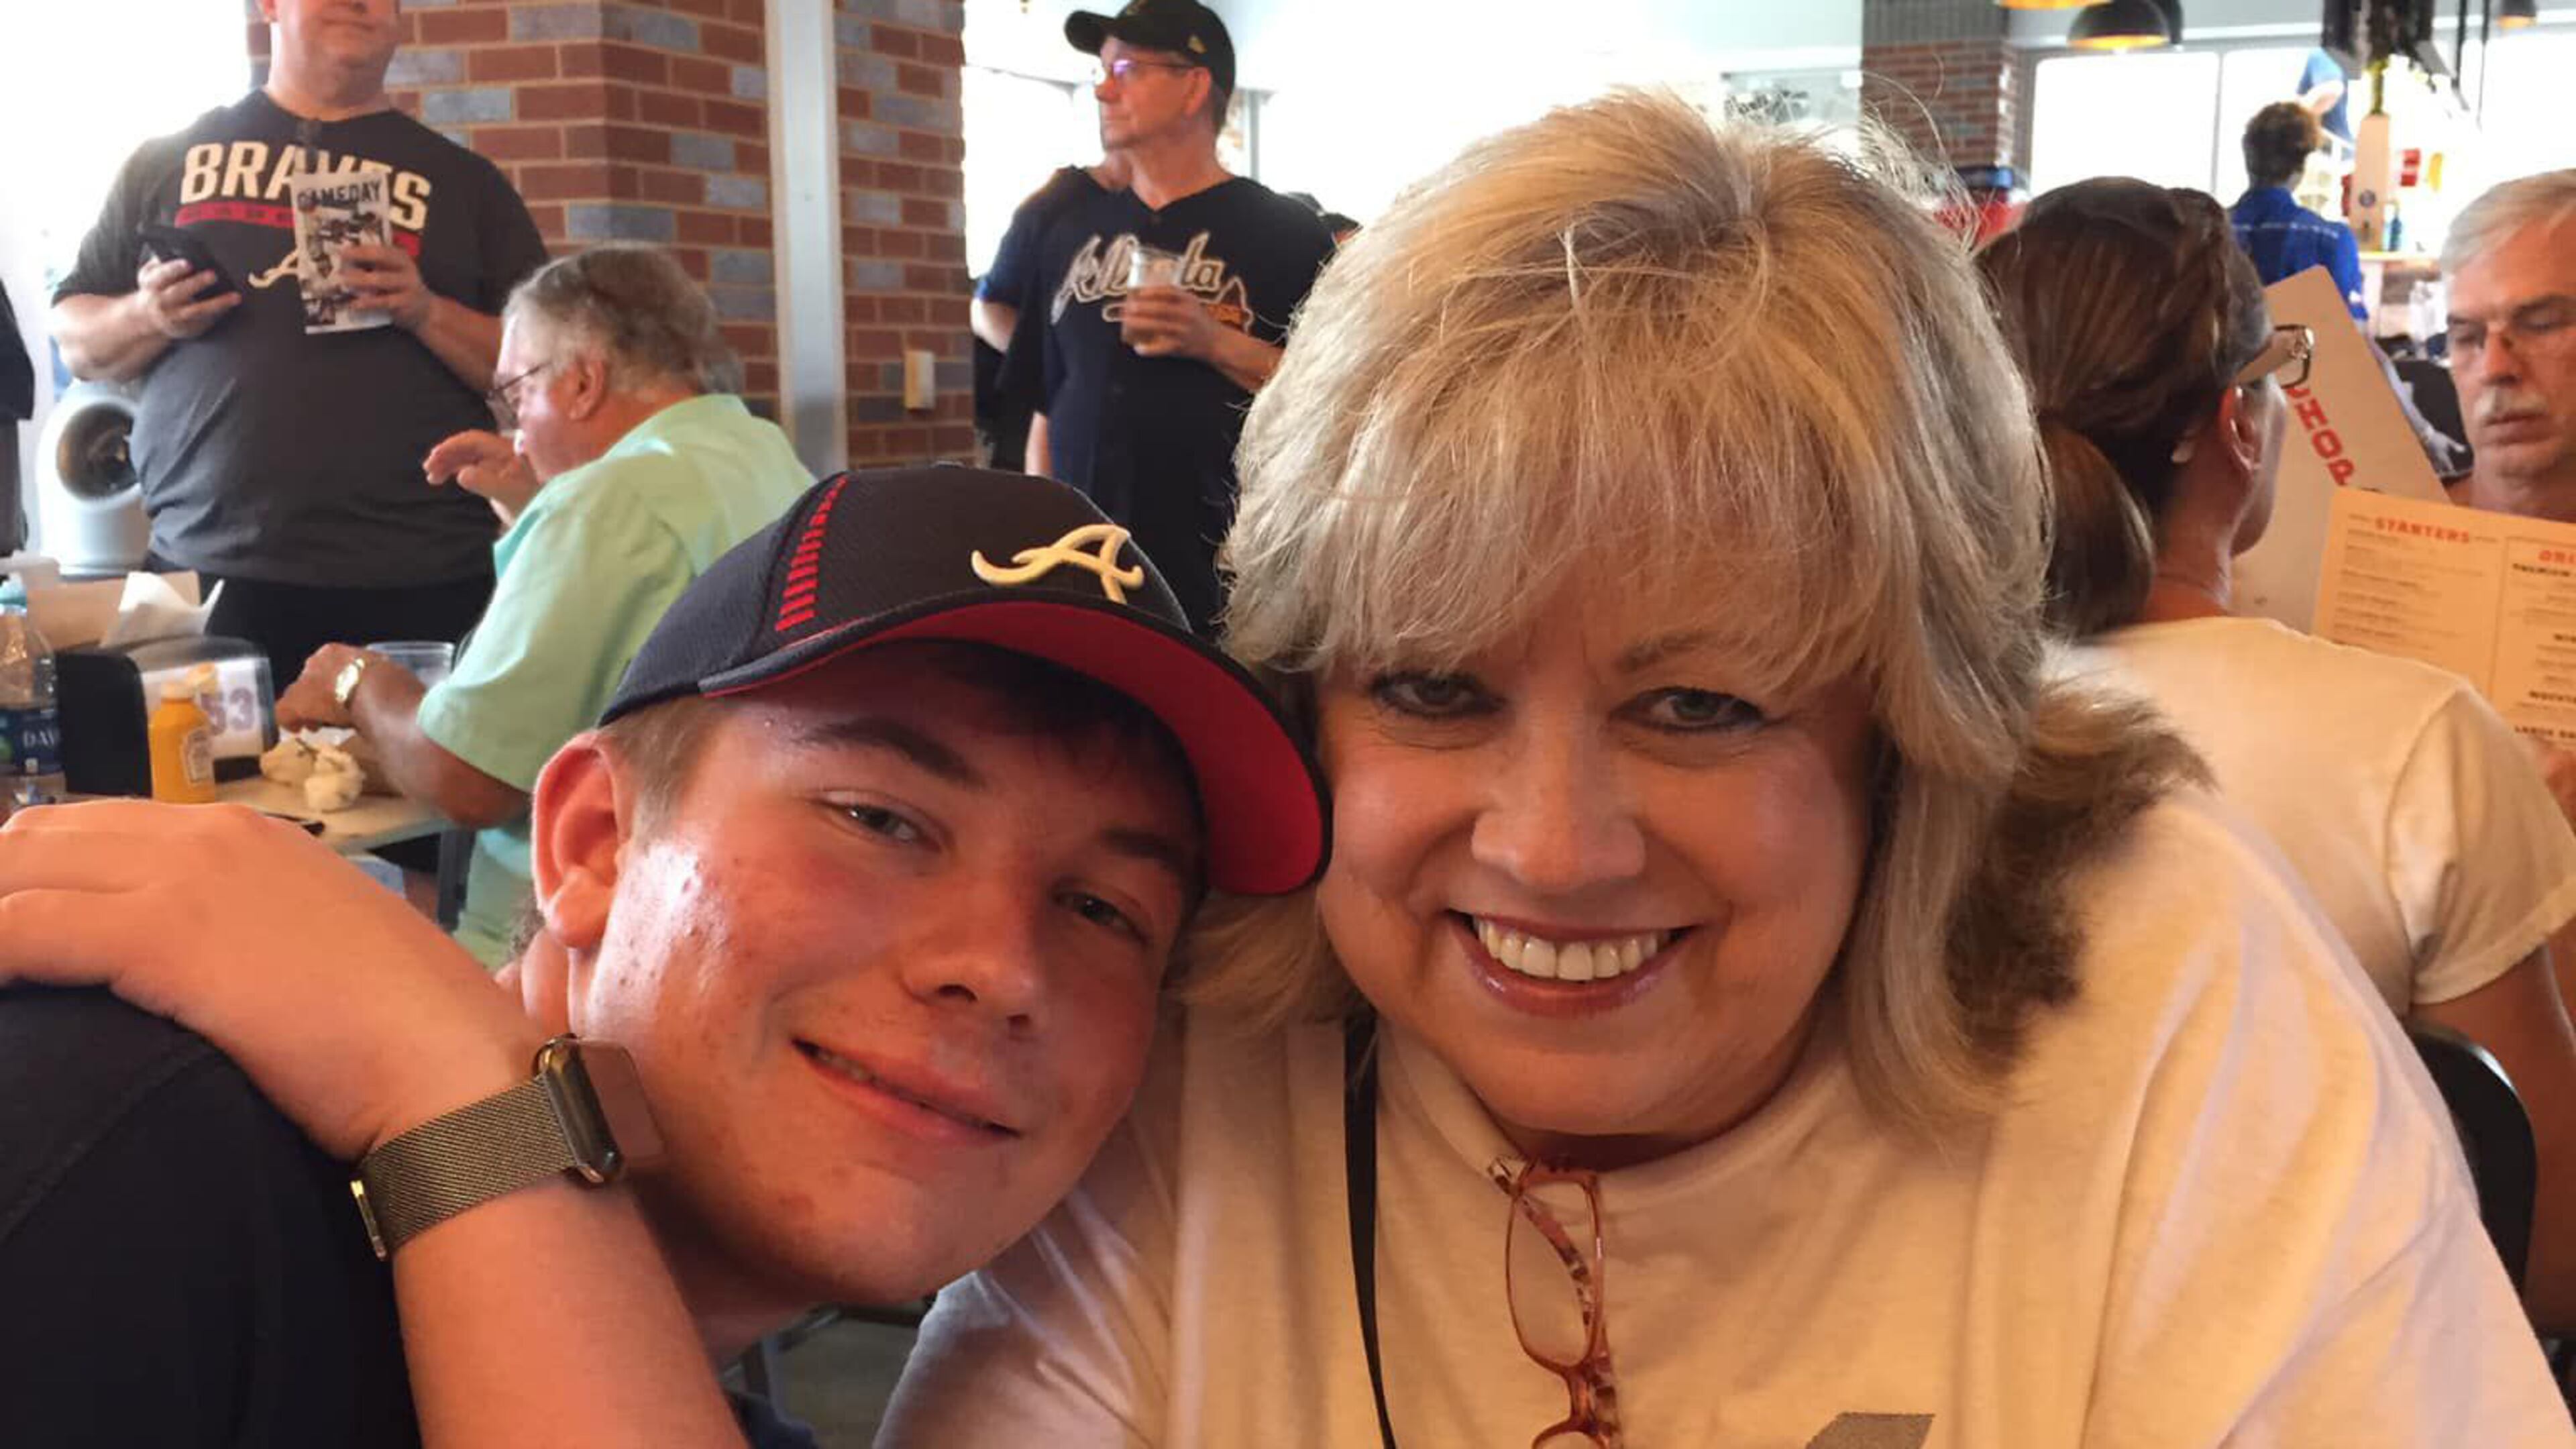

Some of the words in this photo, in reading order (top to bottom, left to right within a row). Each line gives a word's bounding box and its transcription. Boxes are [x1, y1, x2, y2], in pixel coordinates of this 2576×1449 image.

[1050, 230, 1226, 326] Atlta
[2373, 516, 2471, 543] STARTERS
[970, 523, 1144, 605] A
[200, 686, 256, 736] 53
